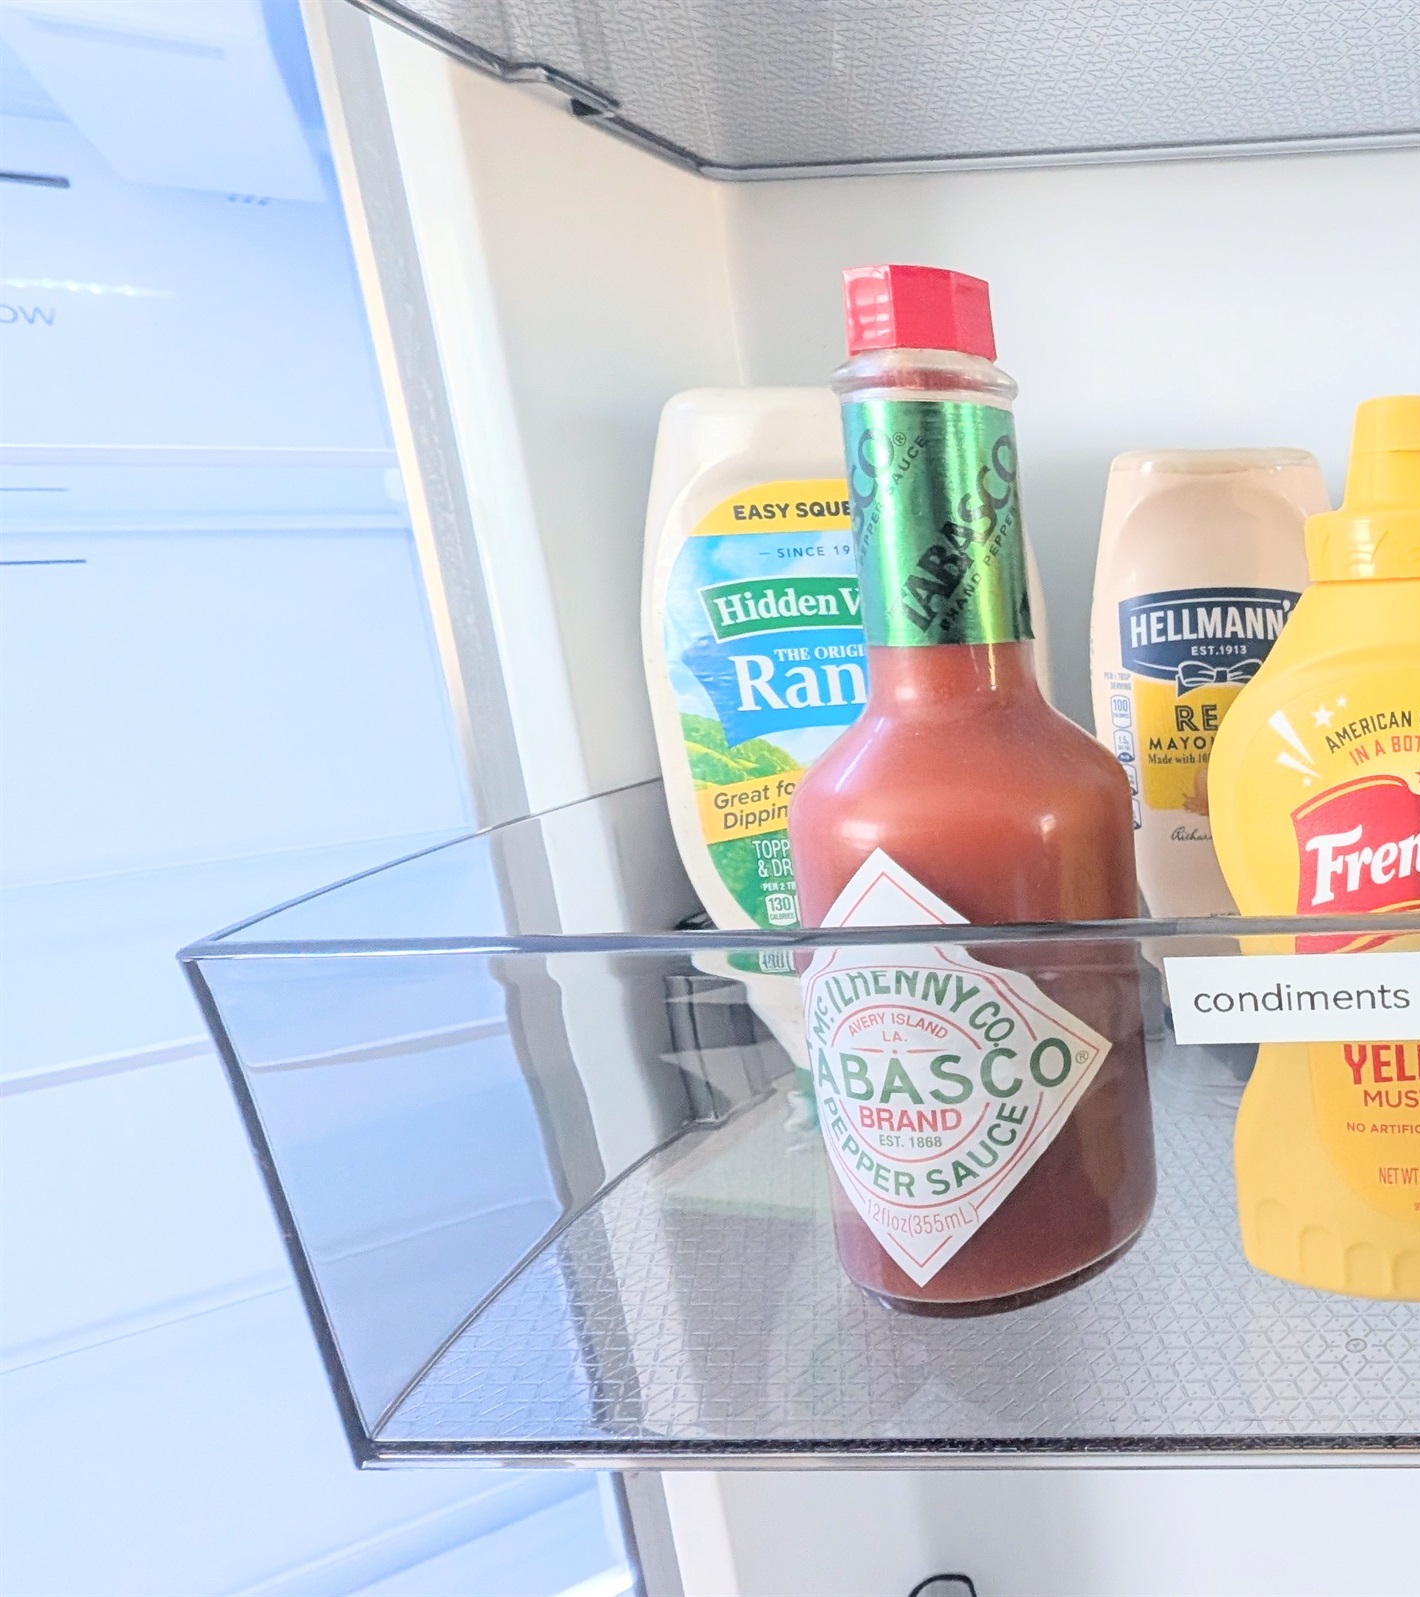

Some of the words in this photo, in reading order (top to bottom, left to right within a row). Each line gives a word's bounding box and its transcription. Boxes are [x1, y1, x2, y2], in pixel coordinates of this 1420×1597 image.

[733, 503, 790, 521] EASY
[796, 500, 850, 518] SQUE
[777, 546, 825, 558] SINCE
[833, 544, 850, 556] 19
[713, 587, 839, 626] Hidden
[774, 648, 810, 662] THE
[814, 644, 866, 659] ORIGI
[728, 654, 868, 711] Ran
[1113, 698, 1128, 712] 100
[1175, 704, 1218, 732] RE
[1325, 710, 1413, 754] AMERICAN
[1148, 753, 1173, 765] Made
[1175, 753, 1196, 764] with
[1350, 748, 1371, 767] IN
[1375, 741, 1387, 756] A
[713, 784, 770, 810] Great
[776, 779, 796, 798] fo
[723, 803, 789, 830] Dippin
[752, 839, 790, 859] TOPP
[762, 882, 778, 891] PER
[768, 896, 791, 911] 130
[1193, 983, 1411, 1014] condiments
[848, 1012, 886, 1037] AVERY
[891, 1013, 948, 1039] ISLAND
[968, 1000, 1016, 1048] CO.
[882, 1030, 908, 1043] LA.
[859, 1105, 963, 1133] BRAND
[1346, 1121, 1366, 1133] NO
[823, 1096, 915, 1198] PEPPER
[927, 1103, 1029, 1196] SAUCE
[879, 1135, 905, 1148] EST.
[908, 1136, 942, 1148] 1868
[1379, 1167, 1399, 1184] NET
[1401, 1168, 1419, 1184] WT
